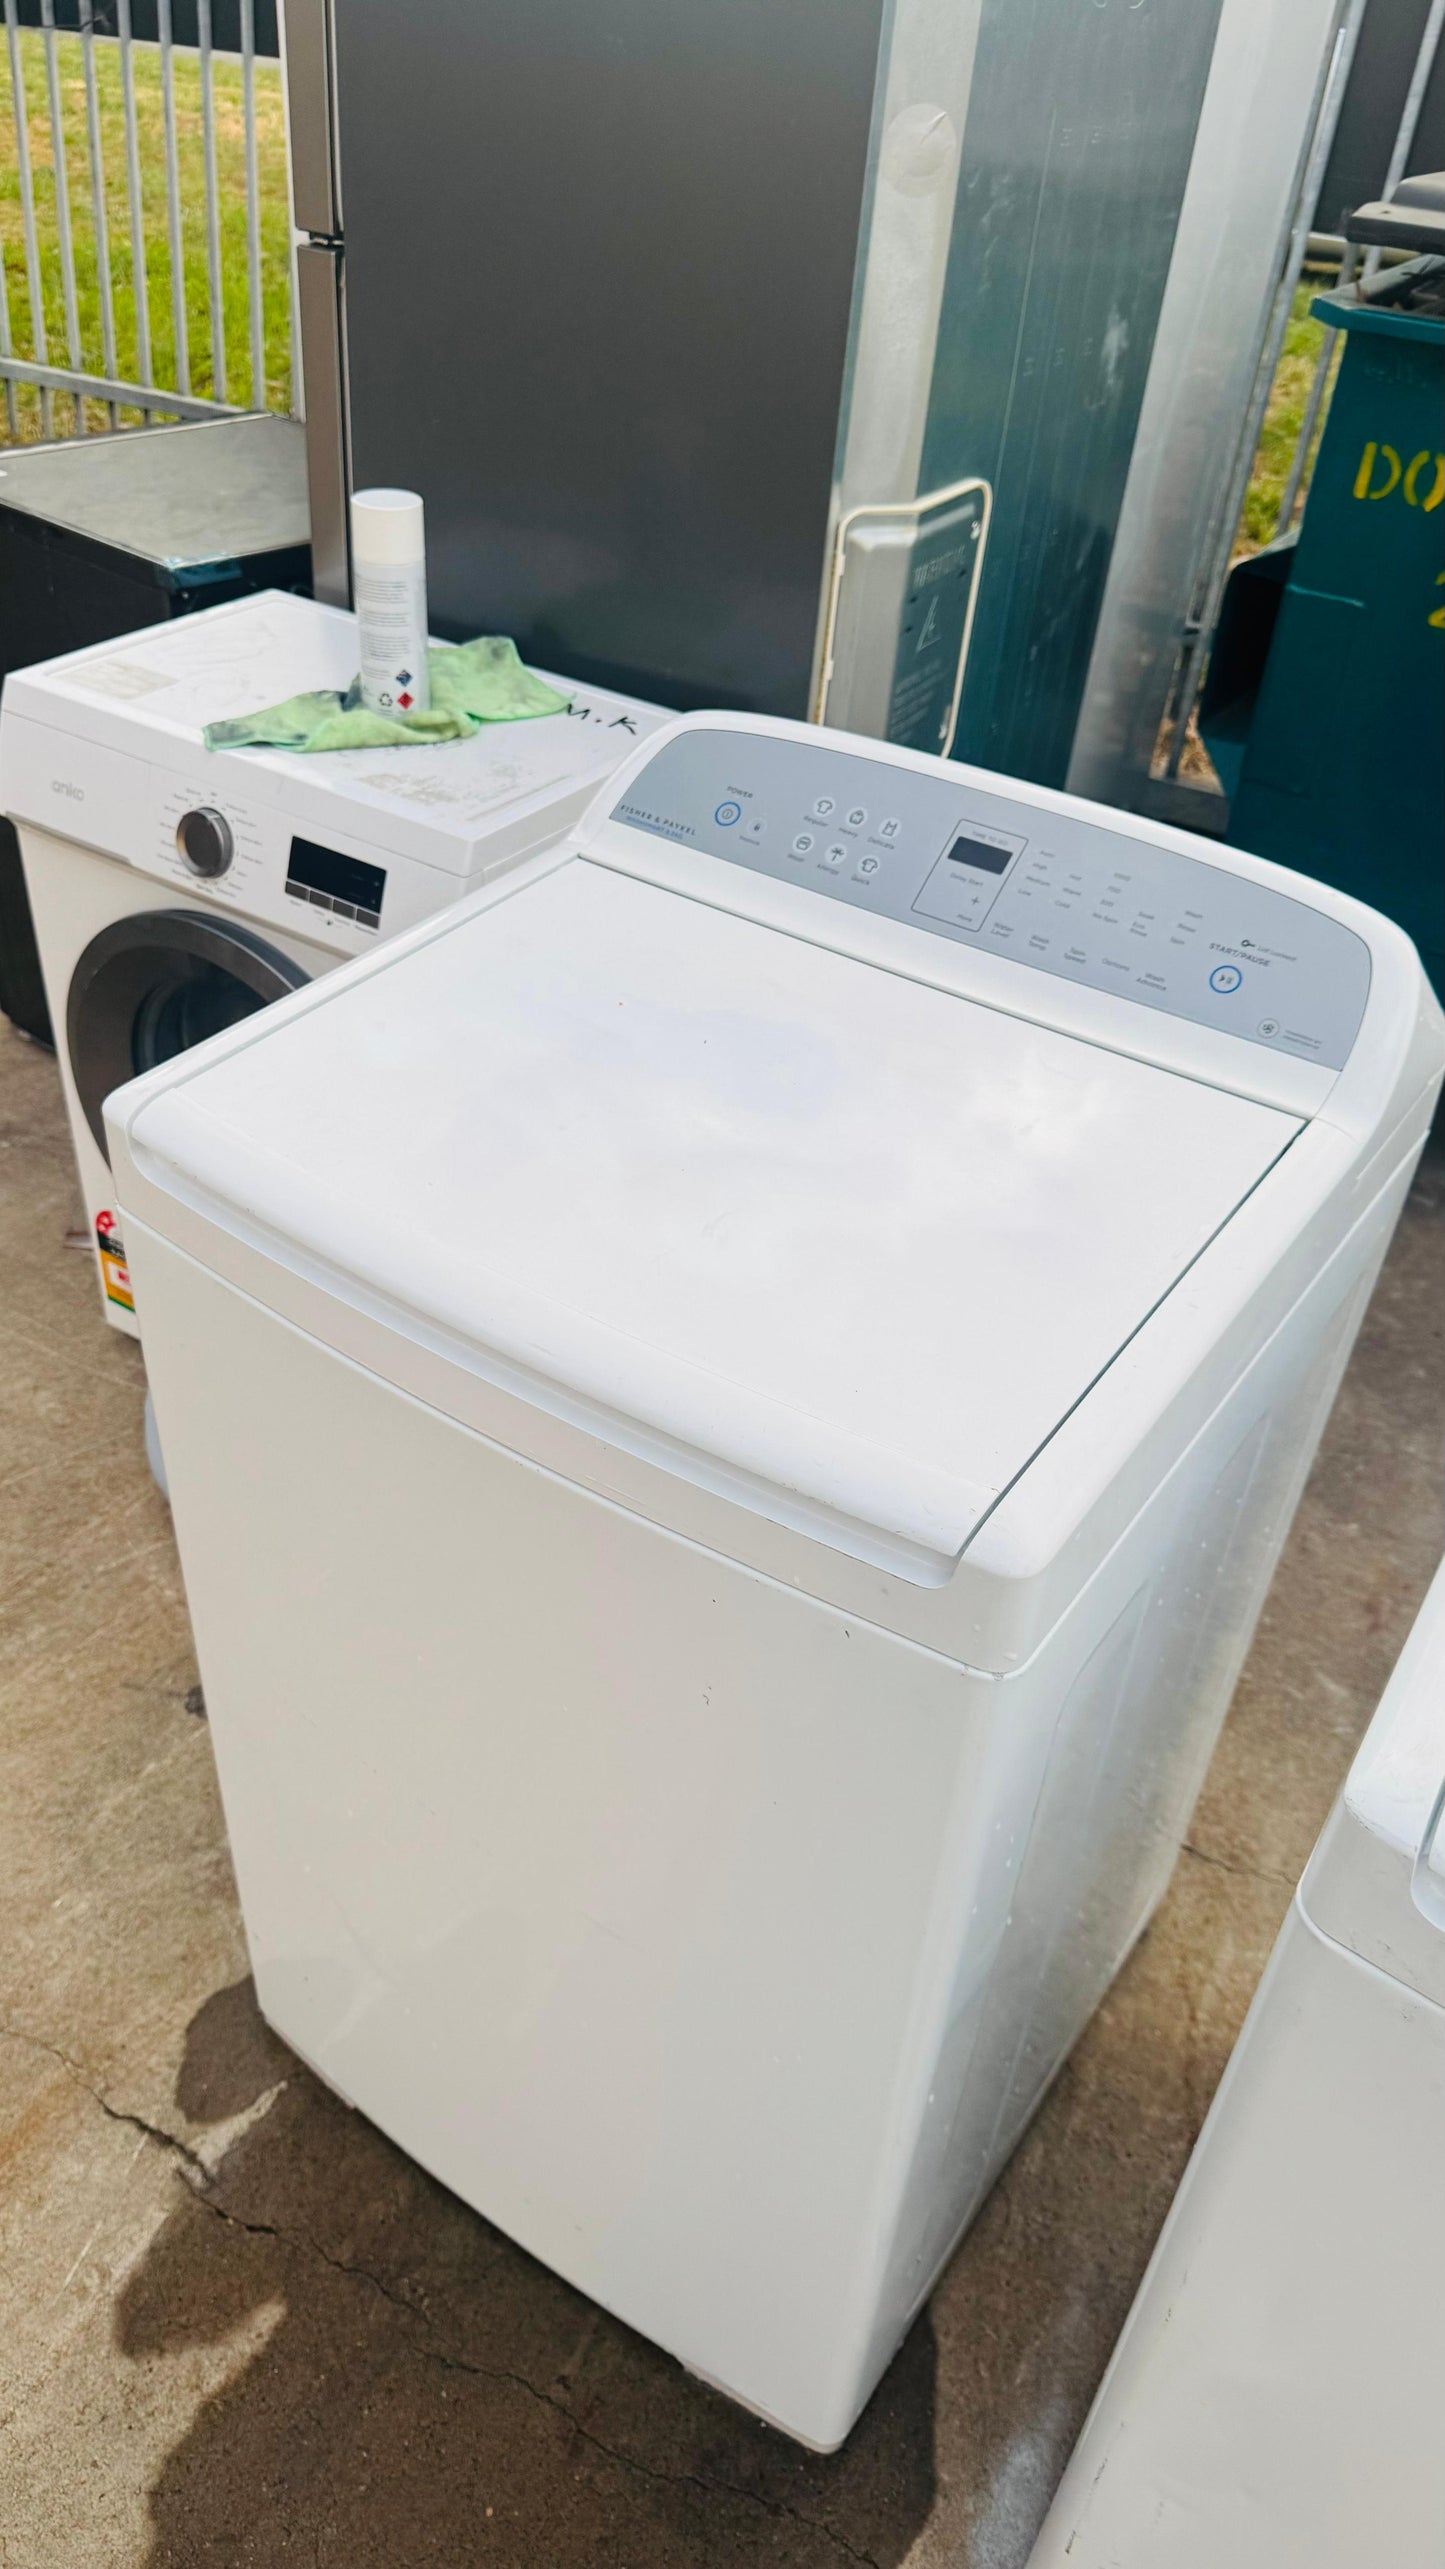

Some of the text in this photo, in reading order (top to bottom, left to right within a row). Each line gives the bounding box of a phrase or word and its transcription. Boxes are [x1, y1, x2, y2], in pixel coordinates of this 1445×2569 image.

[51, 780, 85, 802] anko
[726, 786, 754, 799] POWER
[620, 804, 653, 821] FISHER
[662, 818, 697, 836] PAYKEL
[866, 836, 895, 850] Delicate
[1209, 942, 1272, 968] START/PAUSE
[1101, 957, 1130, 972] Options
